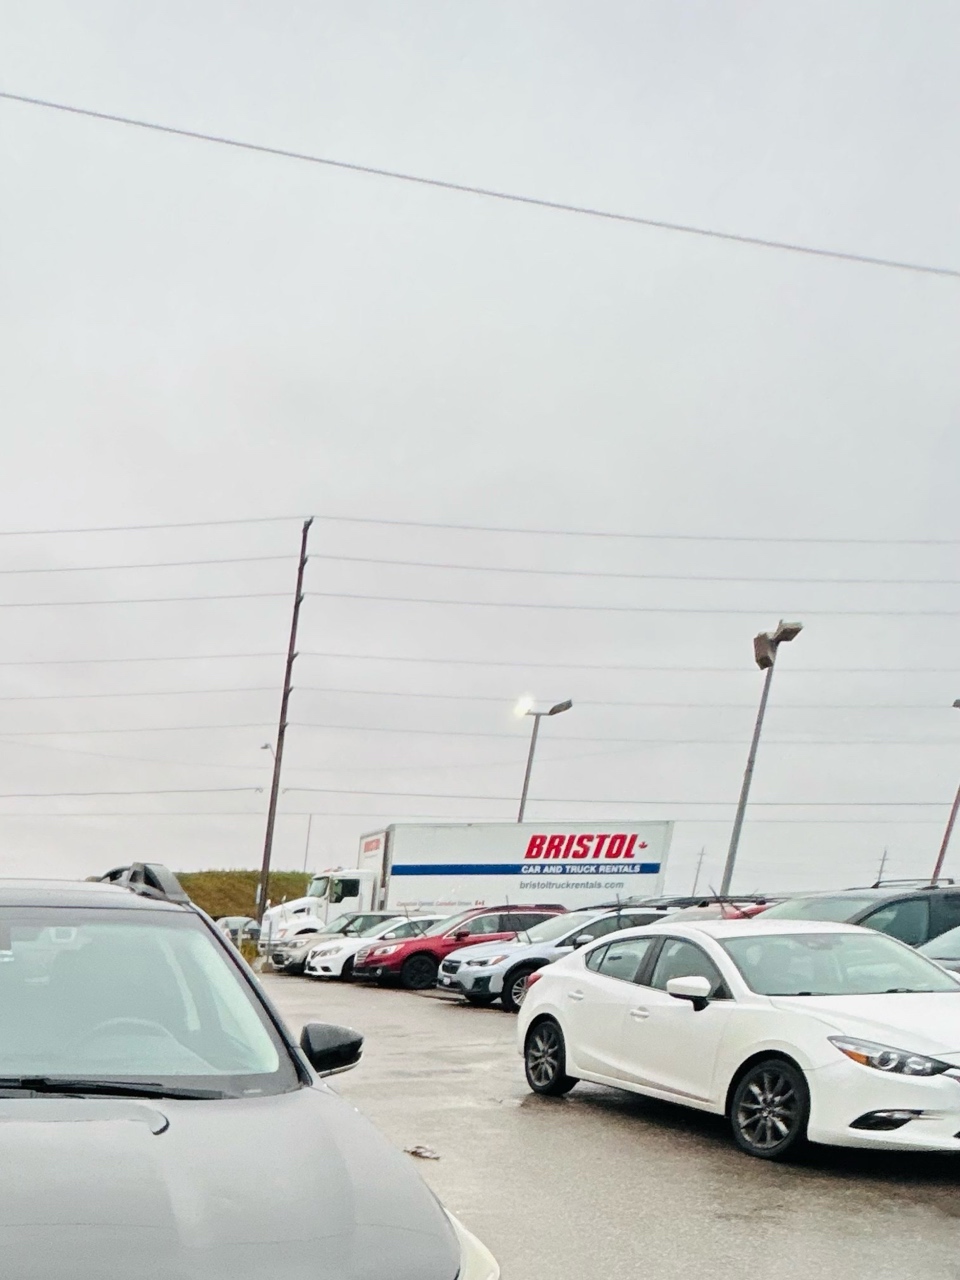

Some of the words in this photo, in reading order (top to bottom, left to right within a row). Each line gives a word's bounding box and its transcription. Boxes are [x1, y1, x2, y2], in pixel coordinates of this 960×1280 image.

[524, 834, 638, 859] BRISTOL
[521, 865, 540, 874] CAR
[542, 865, 563, 874] AND
[565, 865, 597, 874] TRUCK
[598, 865, 640, 874] RENTALS
